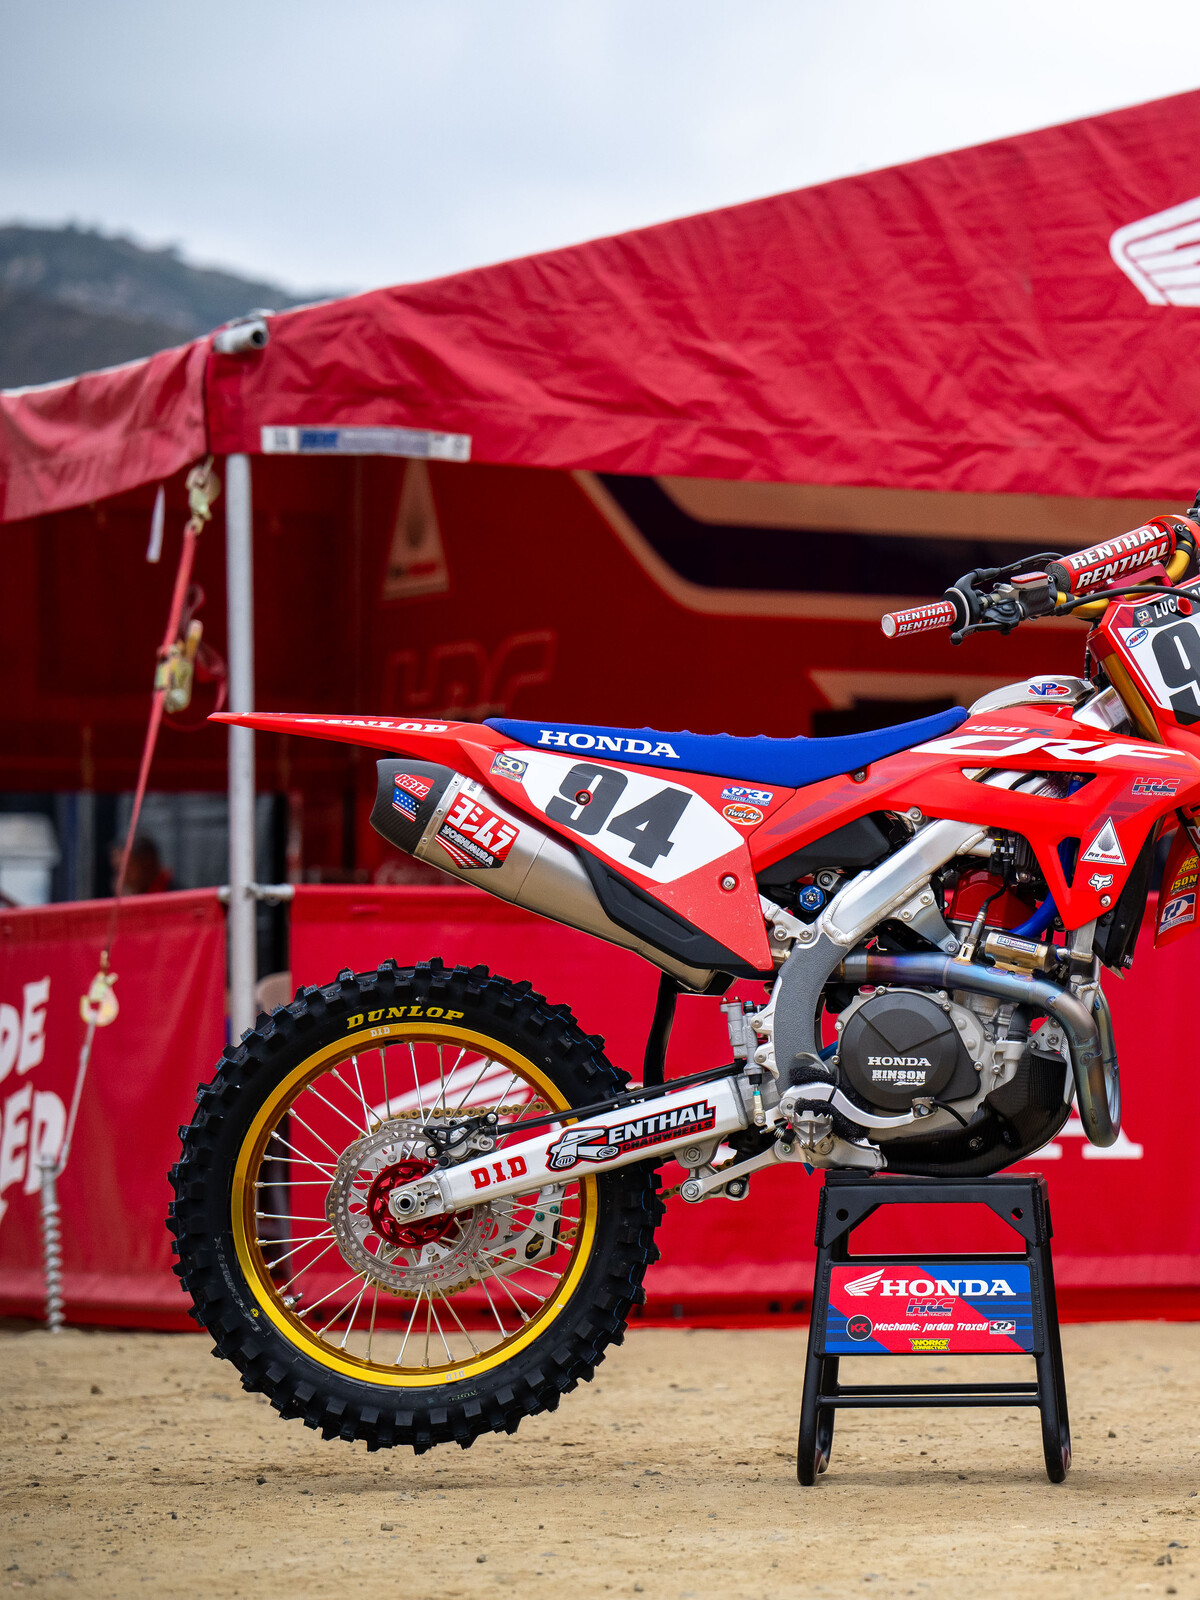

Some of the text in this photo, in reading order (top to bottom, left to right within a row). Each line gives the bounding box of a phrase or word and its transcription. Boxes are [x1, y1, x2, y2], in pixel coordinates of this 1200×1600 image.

[1069, 525, 1168, 570] RENTHAL
[1075, 541, 1170, 590] RENTHAL
[896, 605, 953, 624] RENTHAL
[898, 614, 954, 633] RENTHAL
[1029, 683, 1058, 696] VP
[965, 725, 1055, 737] 450R
[537, 730, 680, 759] HONDA
[910, 735, 1186, 762] CRF
[499, 756, 524, 773] 50
[1132, 777, 1181, 793] HRC
[545, 762, 694, 869] 94
[727, 808, 761, 820] Twin Air
[446, 796, 518, 853] ヨシムラ
[441, 824, 494, 866] YOSHIMURA
[347, 1005, 464, 1029] DUNLOP
[867, 1056, 932, 1067] HONDA
[872, 1069, 926, 1080] HINSON
[622, 1120, 714, 1152] CHAINWHEELS
[470, 1154, 527, 1190] D.I.D
[880, 1279, 1016, 1296] HONDA
[906, 1298, 955, 1313] HRC
[874, 1322, 989, 1333] Mechanic: Jordan Troxell
